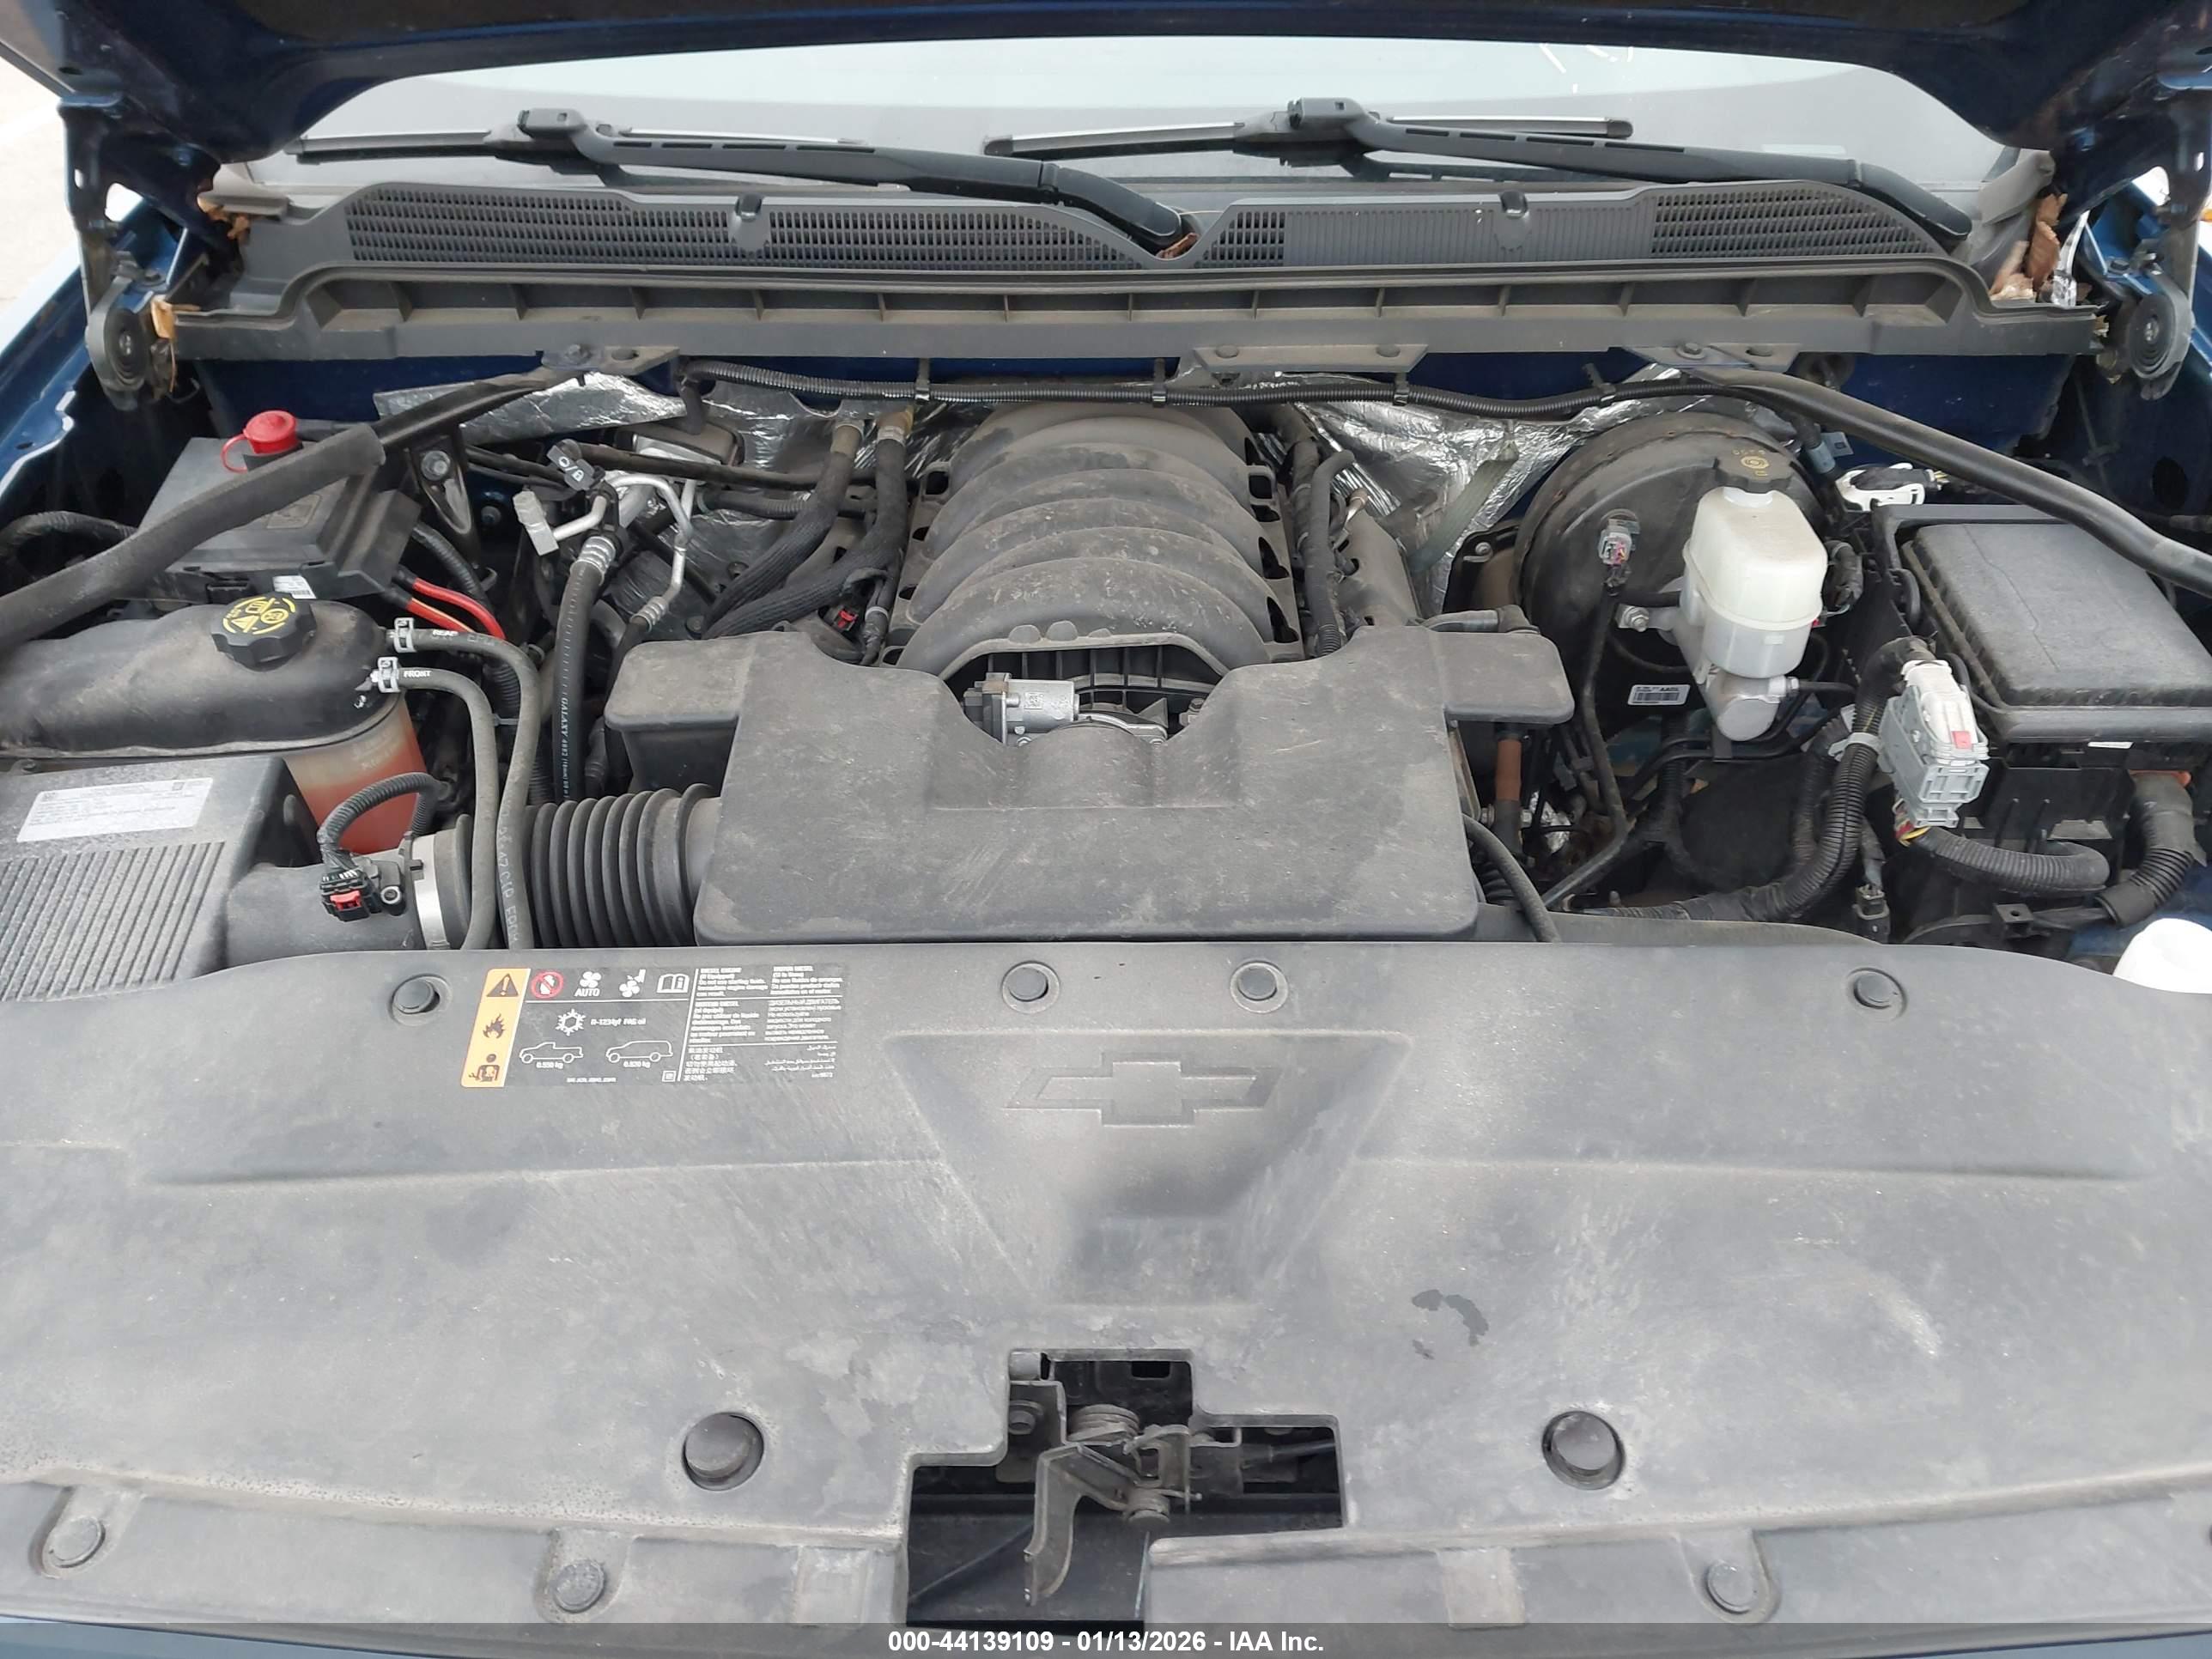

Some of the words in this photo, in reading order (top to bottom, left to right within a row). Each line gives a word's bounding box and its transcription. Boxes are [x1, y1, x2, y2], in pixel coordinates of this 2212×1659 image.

[561, 697, 569, 738] GALAXY
[574, 988, 601, 997] AUTO
[590, 1018, 622, 1027] R-1234yf
[637, 1017, 647, 1025] oil
